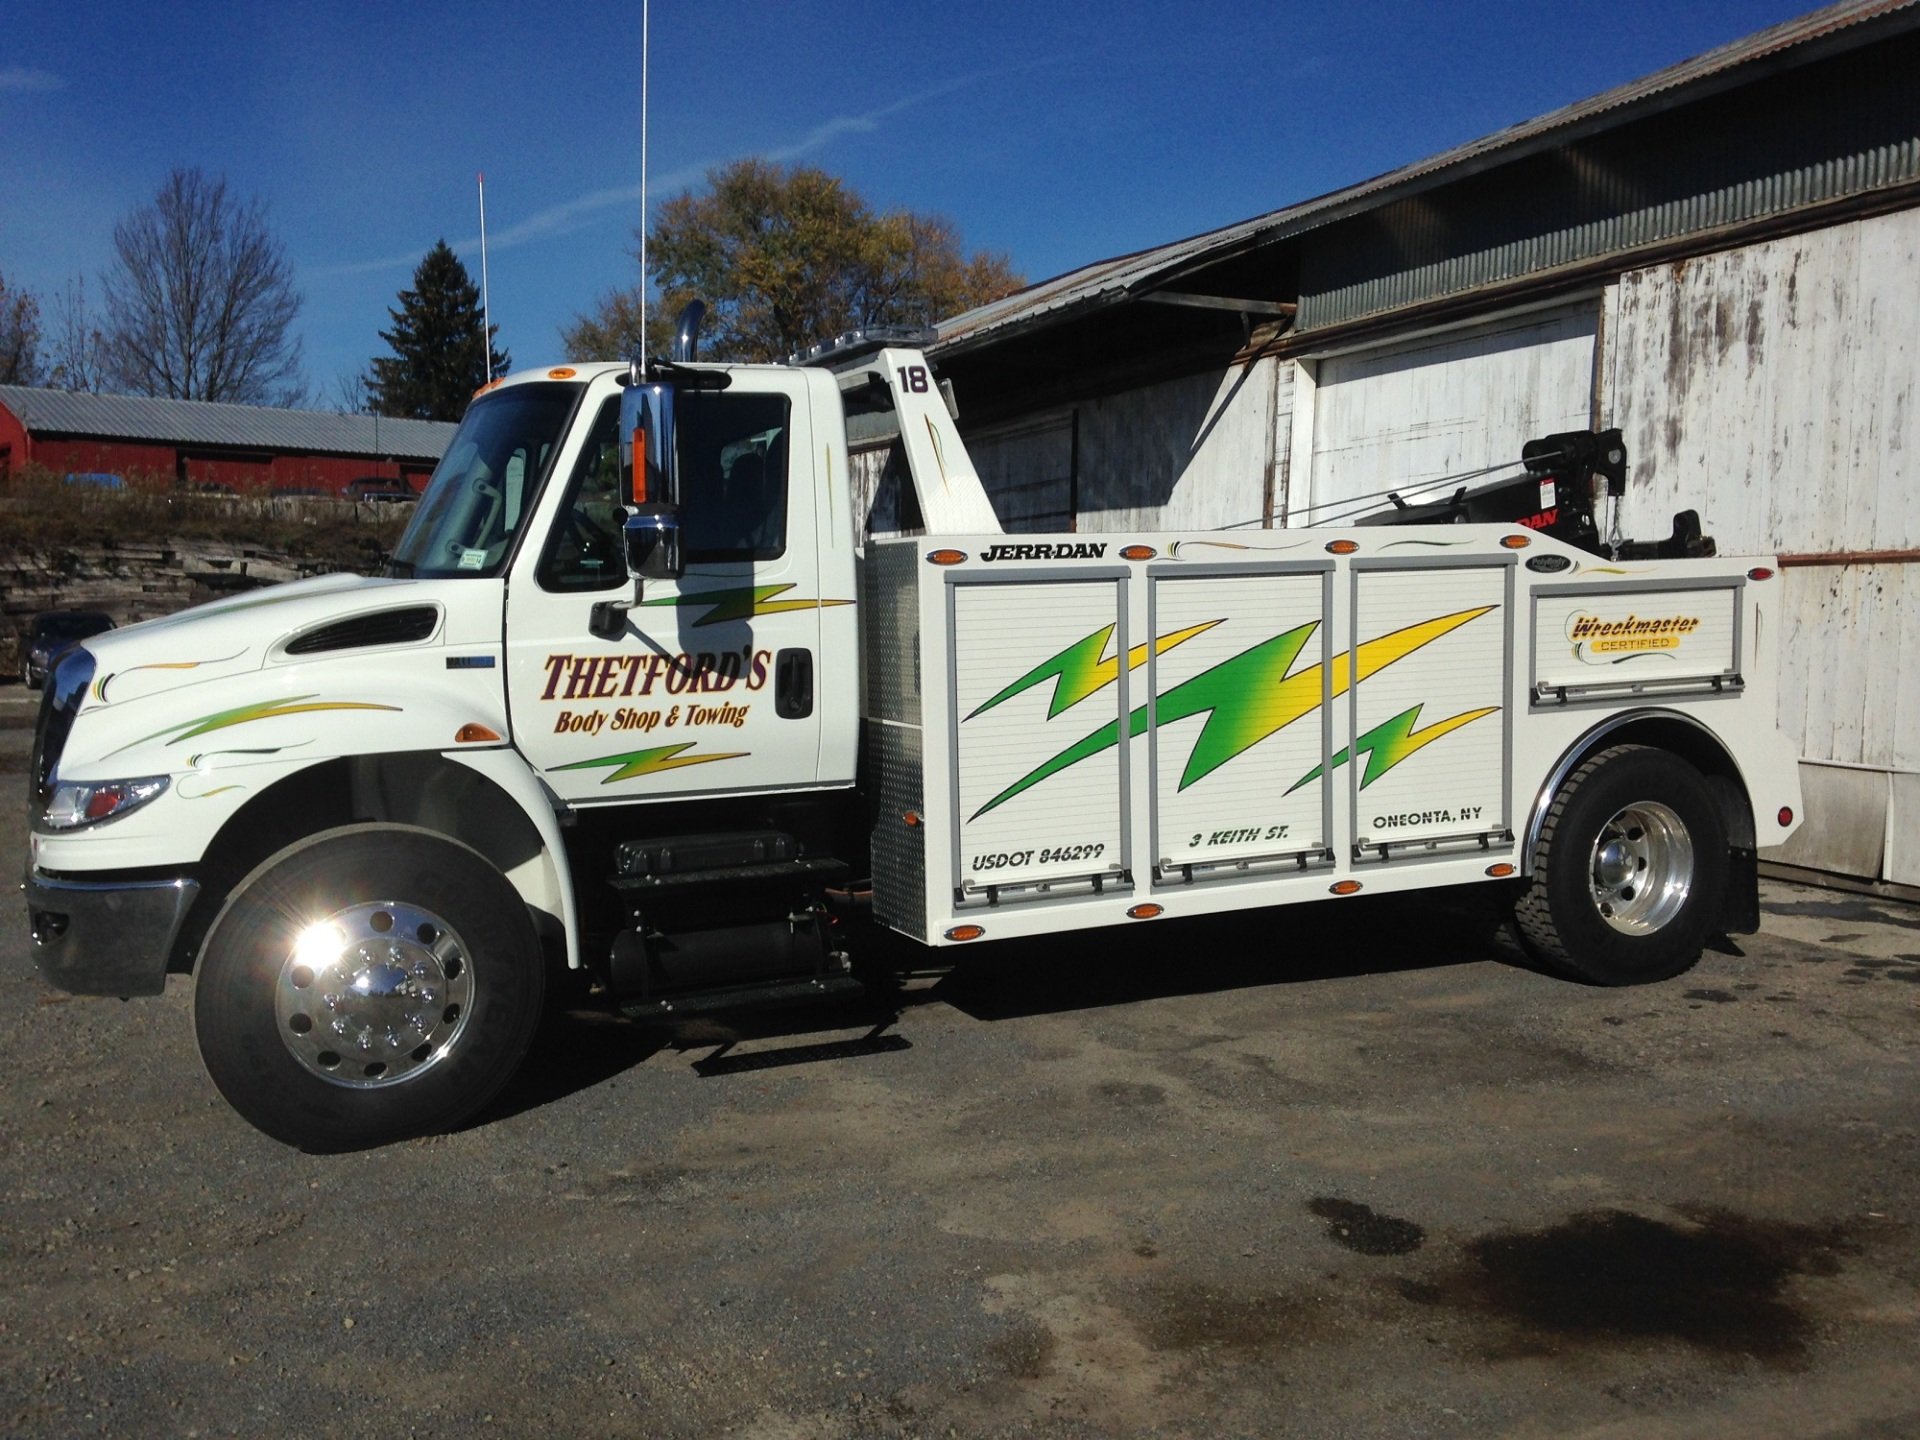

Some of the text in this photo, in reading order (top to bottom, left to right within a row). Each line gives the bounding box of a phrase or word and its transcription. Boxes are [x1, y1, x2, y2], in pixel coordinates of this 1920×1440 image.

[897, 365, 929, 393] 18
[980, 542, 1108, 562] JERR-DAN
[1572, 615, 1700, 638] Wreckmaster
[1600, 638, 1670, 651] CERTIFIED
[540, 649, 772, 701] THETFORD'S
[553, 701, 750, 736] Body Shop & Towing
[1373, 806, 1482, 829] ONEONTA, NY
[1188, 825, 1290, 848] 3 KEITH ST.
[972, 843, 1105, 871] USDOT 846299
